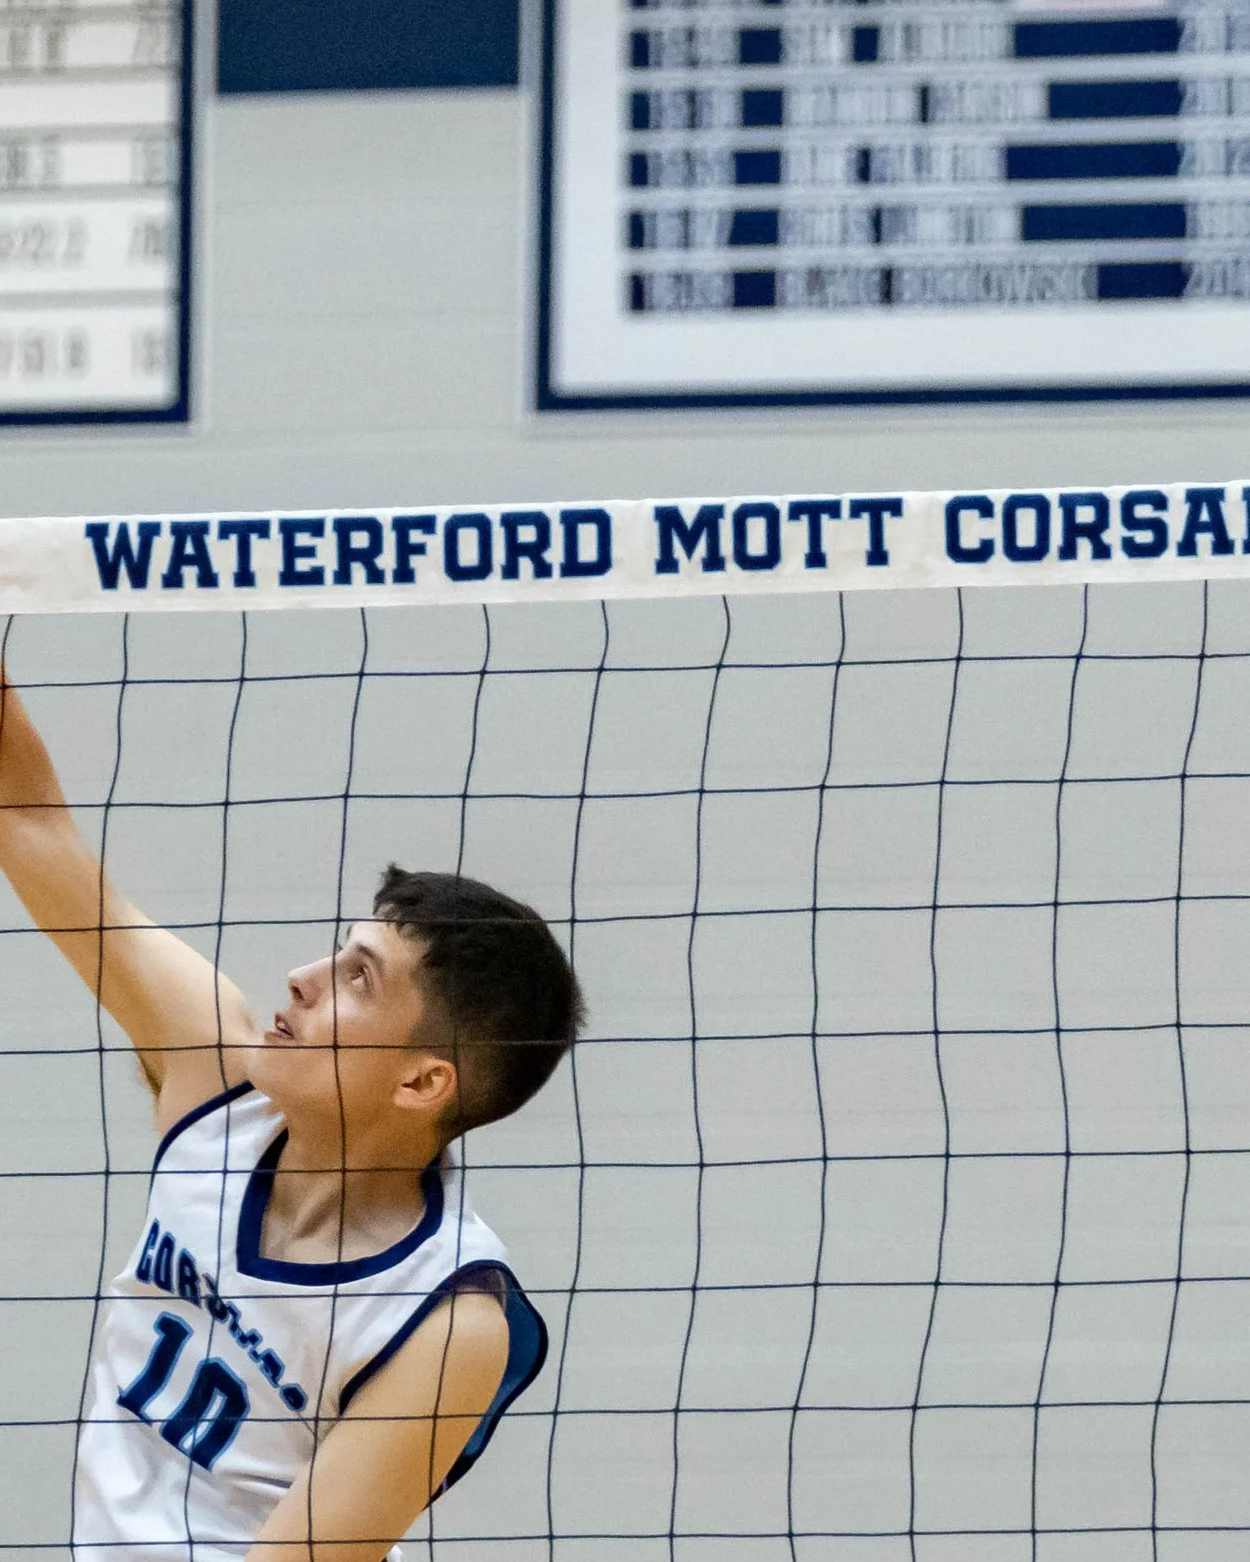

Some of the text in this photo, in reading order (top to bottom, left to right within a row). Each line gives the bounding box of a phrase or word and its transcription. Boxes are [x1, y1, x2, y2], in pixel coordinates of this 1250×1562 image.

[85, 509, 613, 590] WATERFORD
[654, 498, 904, 575] MOTT
[116, 1311, 251, 1473] 10
